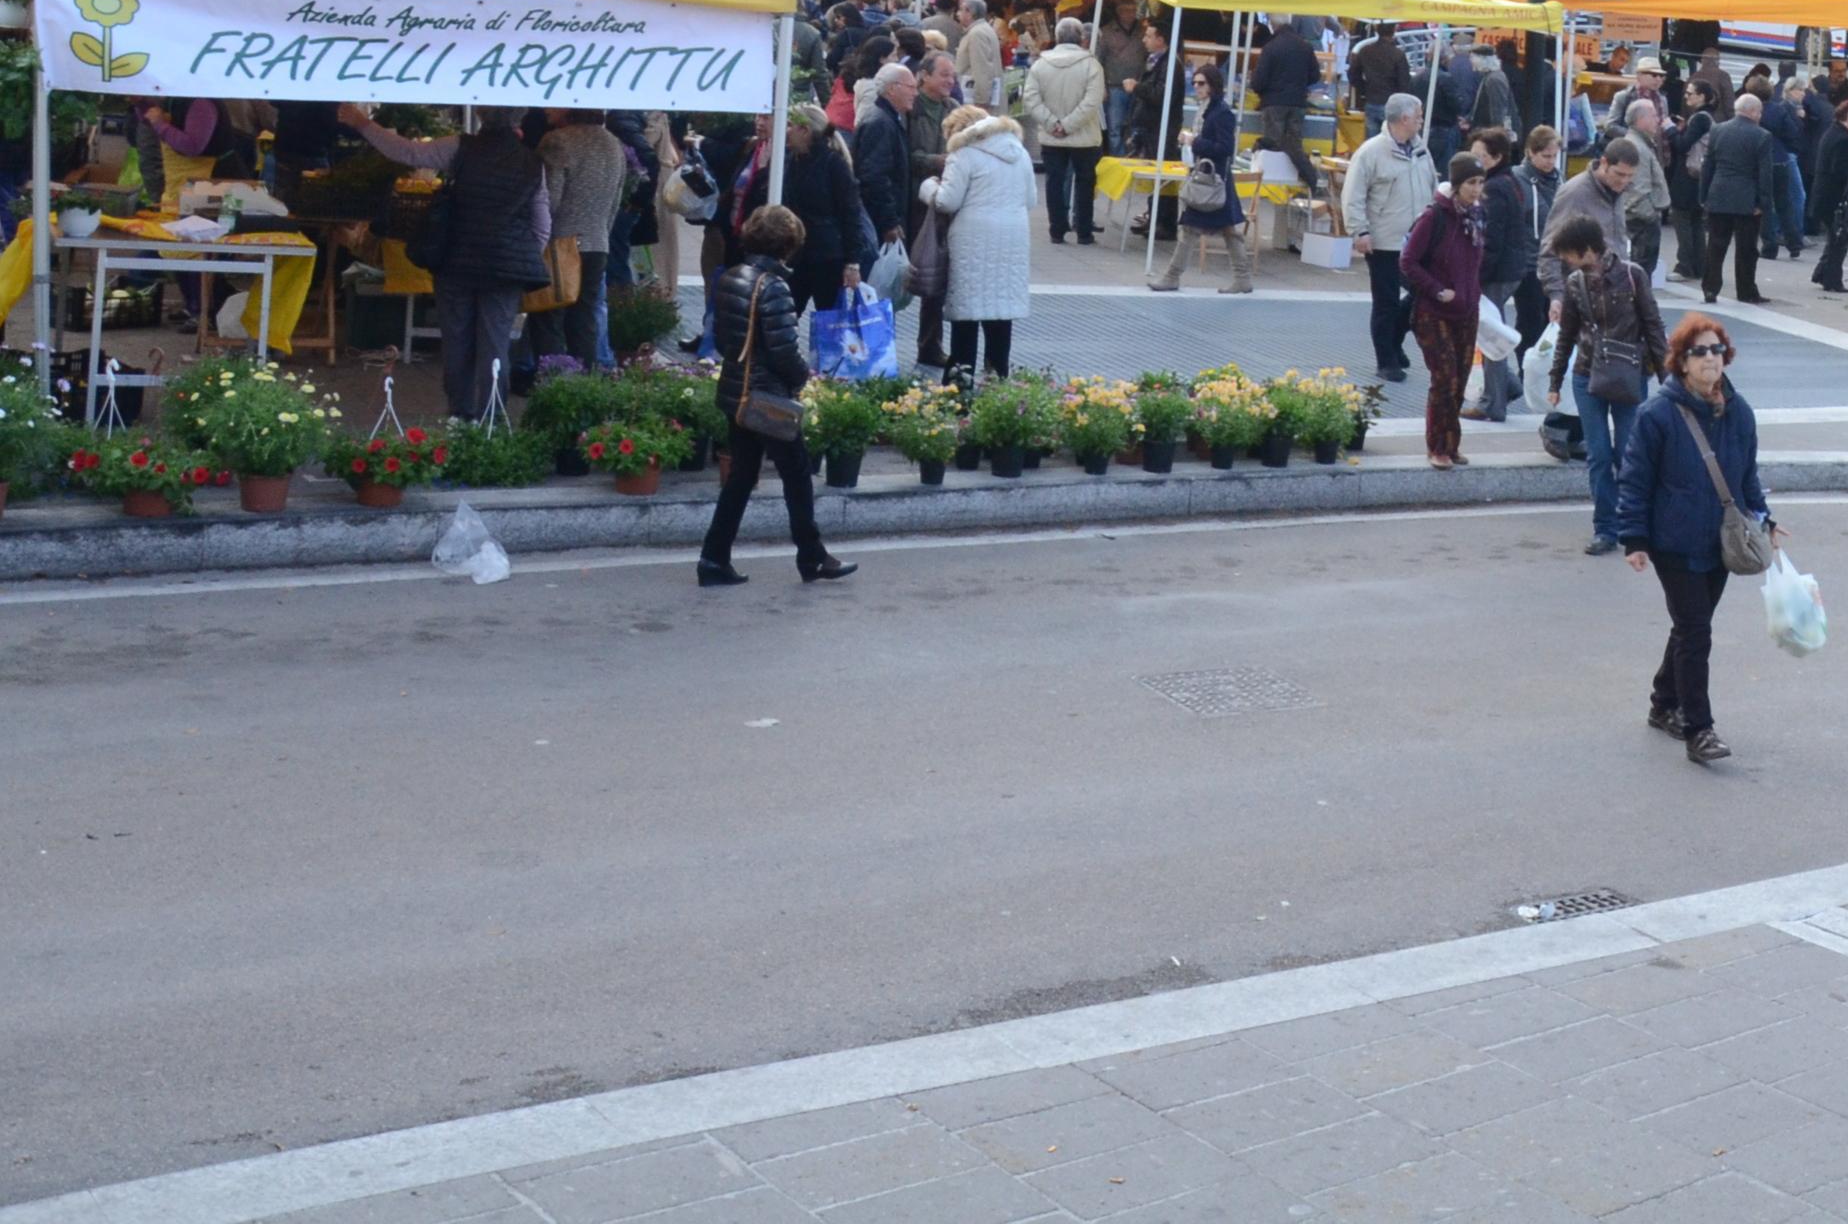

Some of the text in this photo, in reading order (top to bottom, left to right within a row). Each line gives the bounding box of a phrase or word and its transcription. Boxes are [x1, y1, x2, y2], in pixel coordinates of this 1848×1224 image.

[286, 0, 377, 27] Azienda
[385, 5, 476, 36] Agraria
[484, 10, 511, 31] di
[1420, 0, 1497, 17] CAMPAGNA
[189, 30, 745, 100] FRATELLI ARGHITTU
